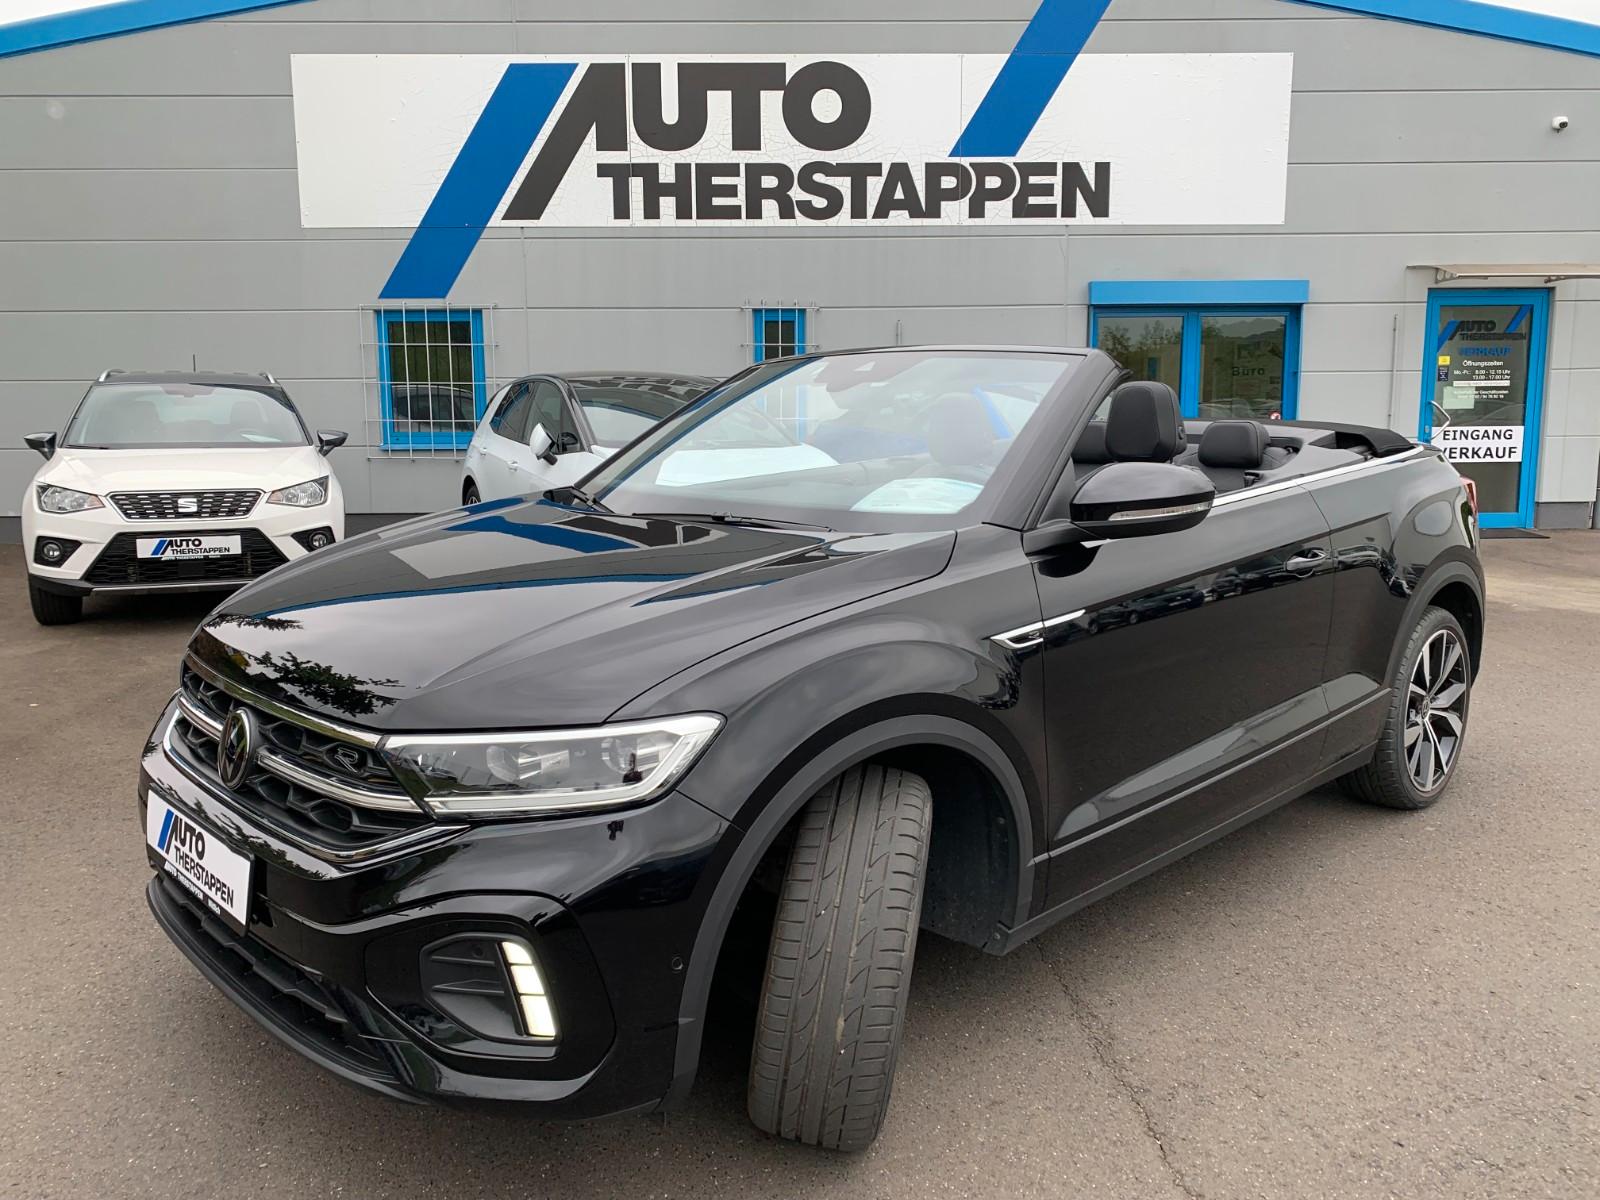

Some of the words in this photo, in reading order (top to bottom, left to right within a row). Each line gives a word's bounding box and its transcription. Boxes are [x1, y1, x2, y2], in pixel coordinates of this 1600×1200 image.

[502, 61, 871, 220] AUTO
[597, 161, 1110, 220] THERSTAPPEN
[1448, 320, 1497, 340] AUTO
[1443, 429, 1513, 440] EINGANG
[160, 538, 202, 555] AUTO
[171, 547, 230, 555] THERSTAPPEN
[165, 814, 206, 860] AUTO
[174, 845, 234, 908] THERSTAPPEN
